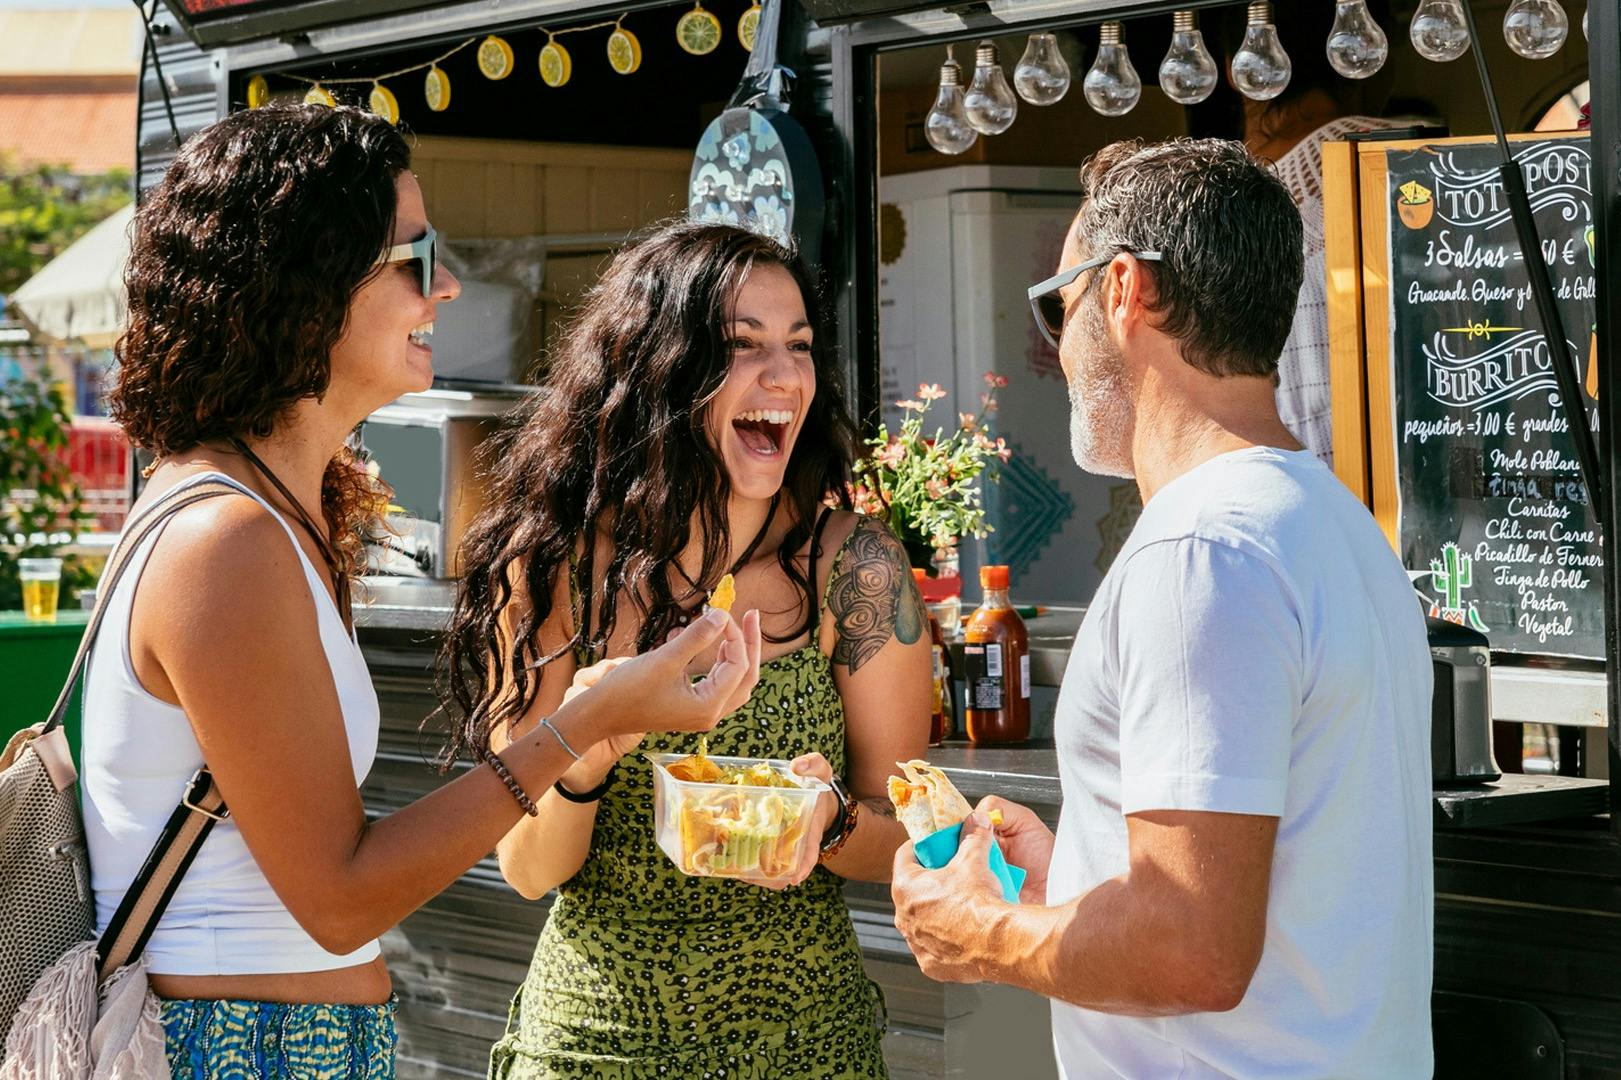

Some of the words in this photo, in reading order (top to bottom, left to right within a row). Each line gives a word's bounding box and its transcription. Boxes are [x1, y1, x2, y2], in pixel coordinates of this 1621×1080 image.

[1444, 152, 1580, 219] TOTPOS
[1424, 240, 1435, 267] 3
[1436, 229, 1509, 269] Salsas
[1561, 238, 1576, 266] €
[1471, 278, 1516, 306] Queso
[1516, 287, 1526, 312] y
[1557, 277, 1572, 300] de
[1573, 275, 1596, 301] Gall
[1434, 340, 1553, 401] BURRITO
[1504, 411, 1517, 436] €
[1522, 409, 1569, 443] grandes
[1490, 448, 1529, 472] Mole
[1530, 448, 1580, 471] Poblan
[1507, 496, 1571, 519] Carnitas
[1485, 517, 1524, 540] Chili
[1526, 528, 1548, 541] con
[1549, 521, 1595, 543] Carne
[1474, 541, 1537, 563] Picadillo
[1539, 545, 1554, 566] de
[1555, 545, 1604, 567] Terner
[1493, 565, 1534, 595] Tinga
[1535, 568, 1550, 588] de
[1551, 568, 1591, 589] Pollo
[1520, 590, 1569, 612] Pastor
[1518, 612, 1574, 644] Vegetal
